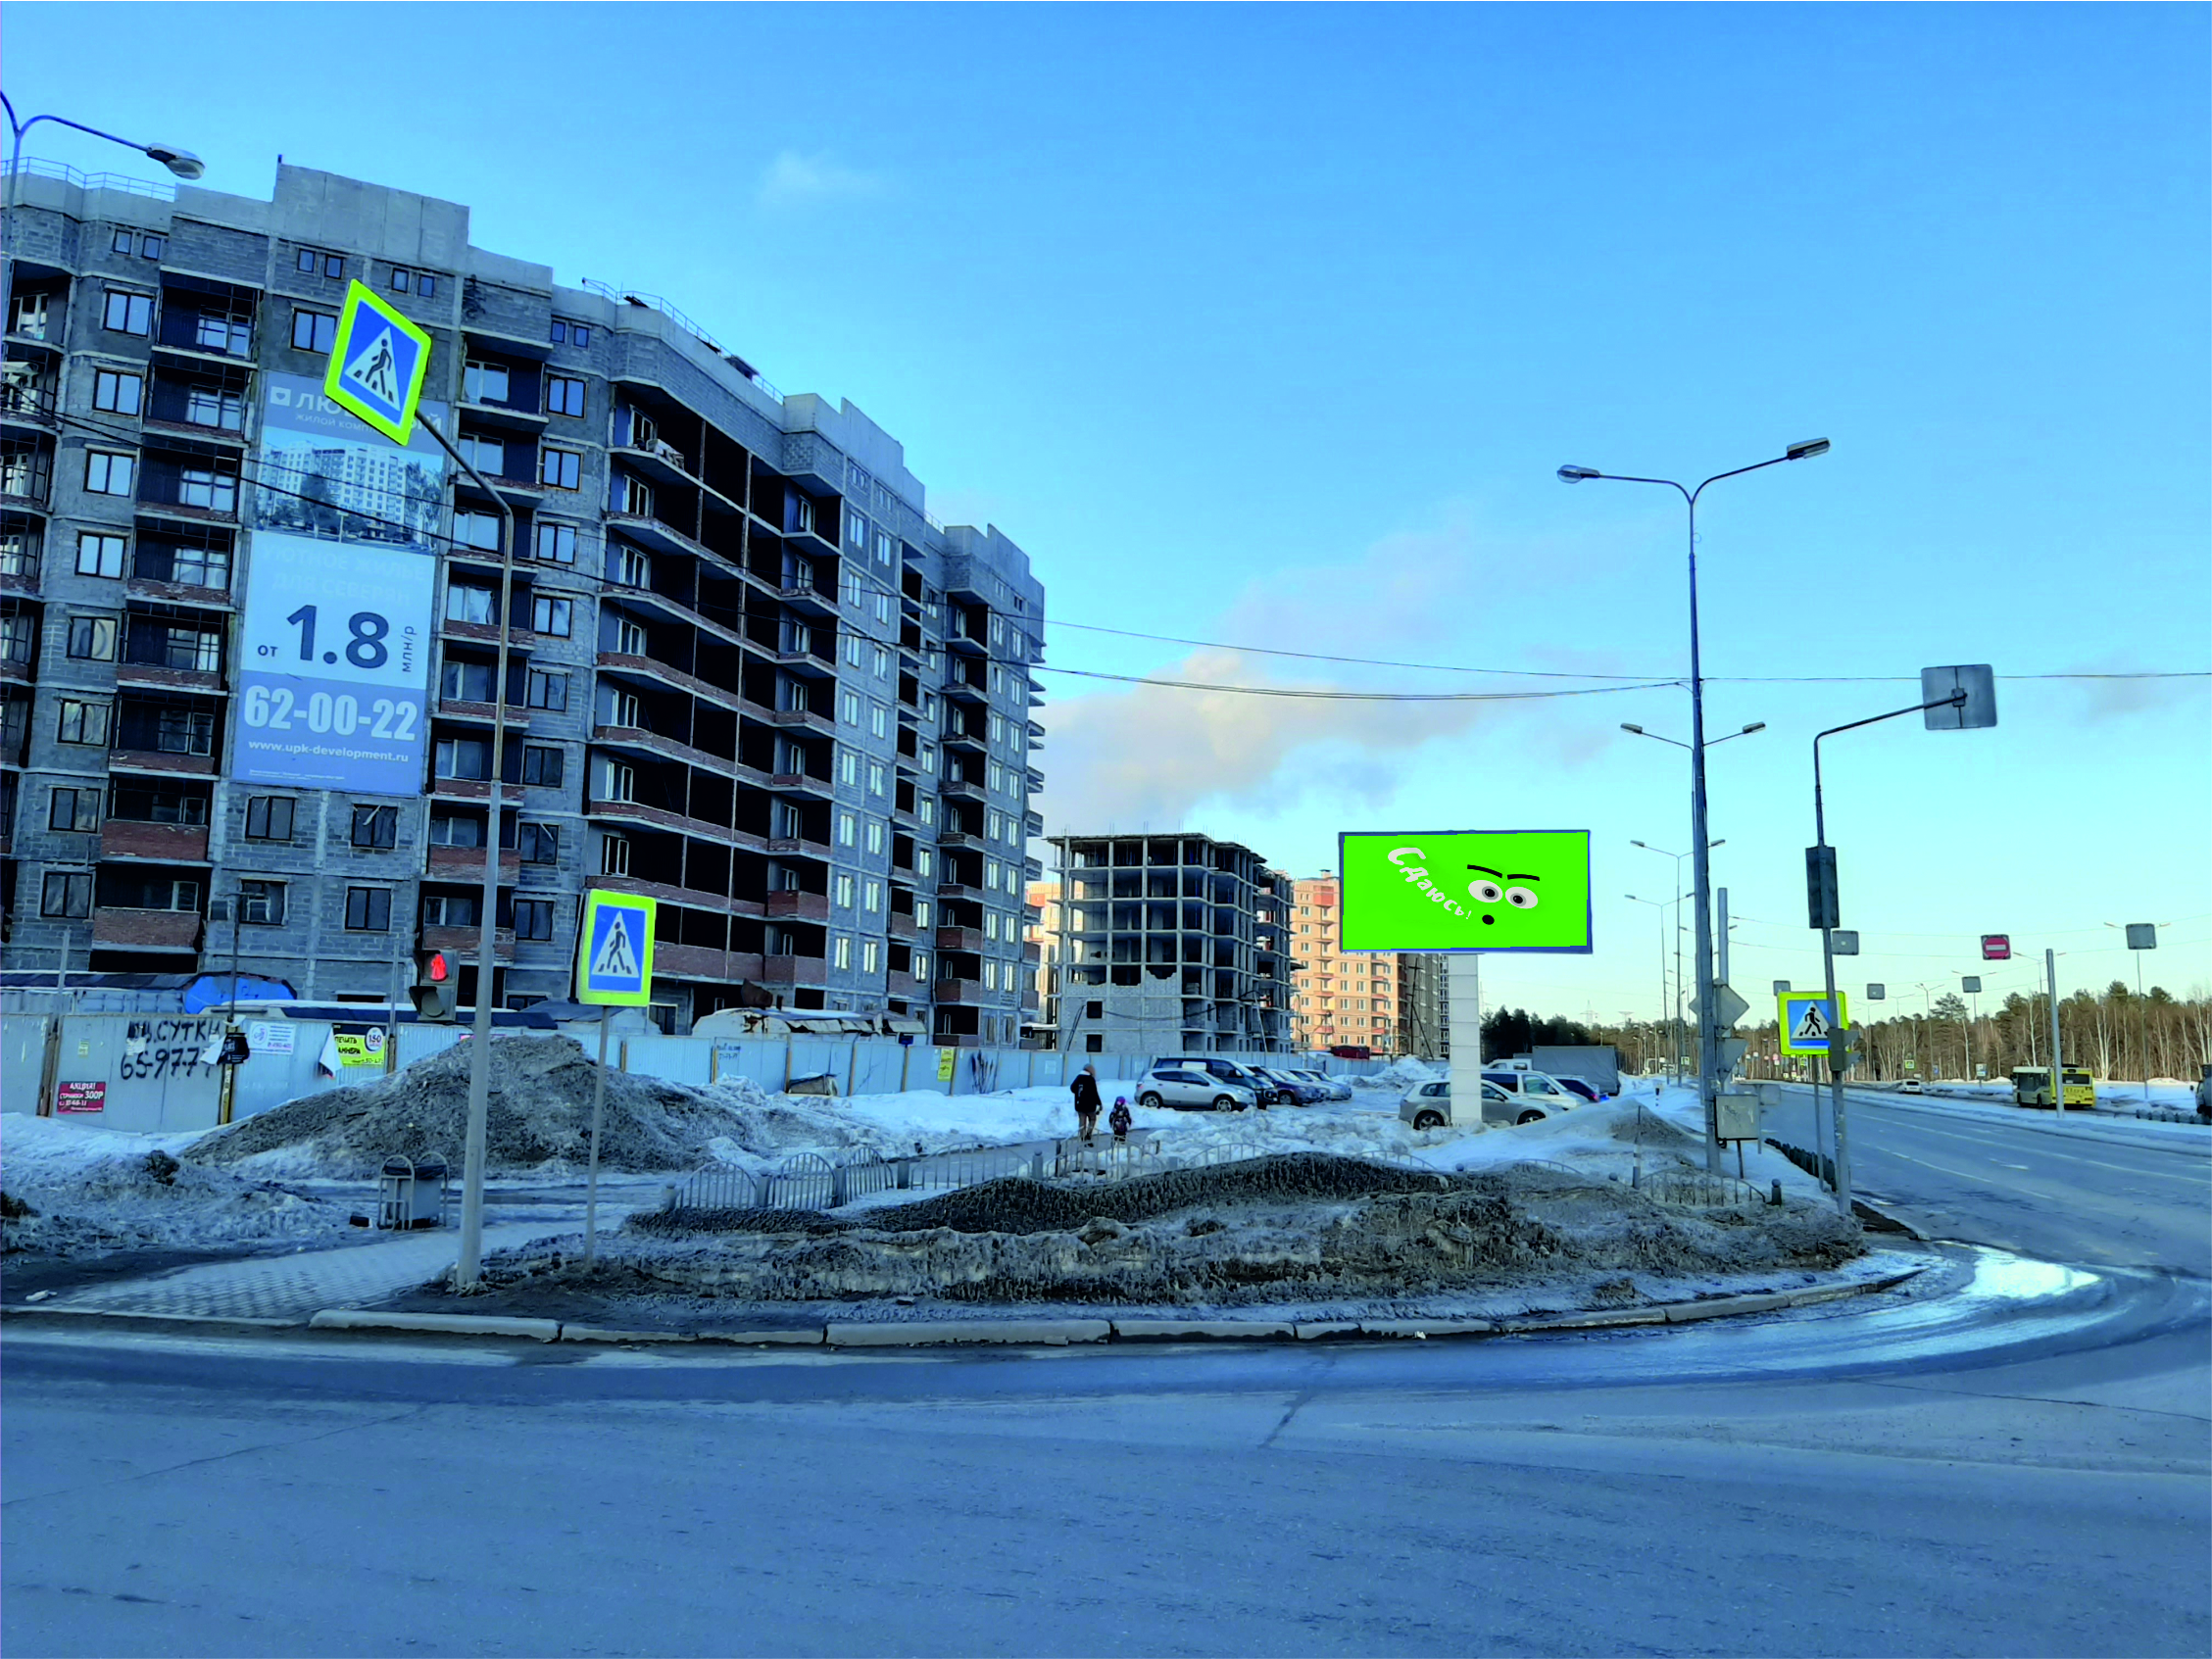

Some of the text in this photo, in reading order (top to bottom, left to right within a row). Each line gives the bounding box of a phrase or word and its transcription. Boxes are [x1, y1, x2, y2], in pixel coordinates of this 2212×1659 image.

[295, 413, 336, 427] ЖИЛОЙ
[262, 544, 347, 570] УЮТНОЕ
[321, 579, 410, 605] СЕВЕРЯН
[286, 605, 389, 669] 1.8
[245, 685, 418, 741] 62-00-22
[248, 741, 409, 762] www.upk-development.ru
